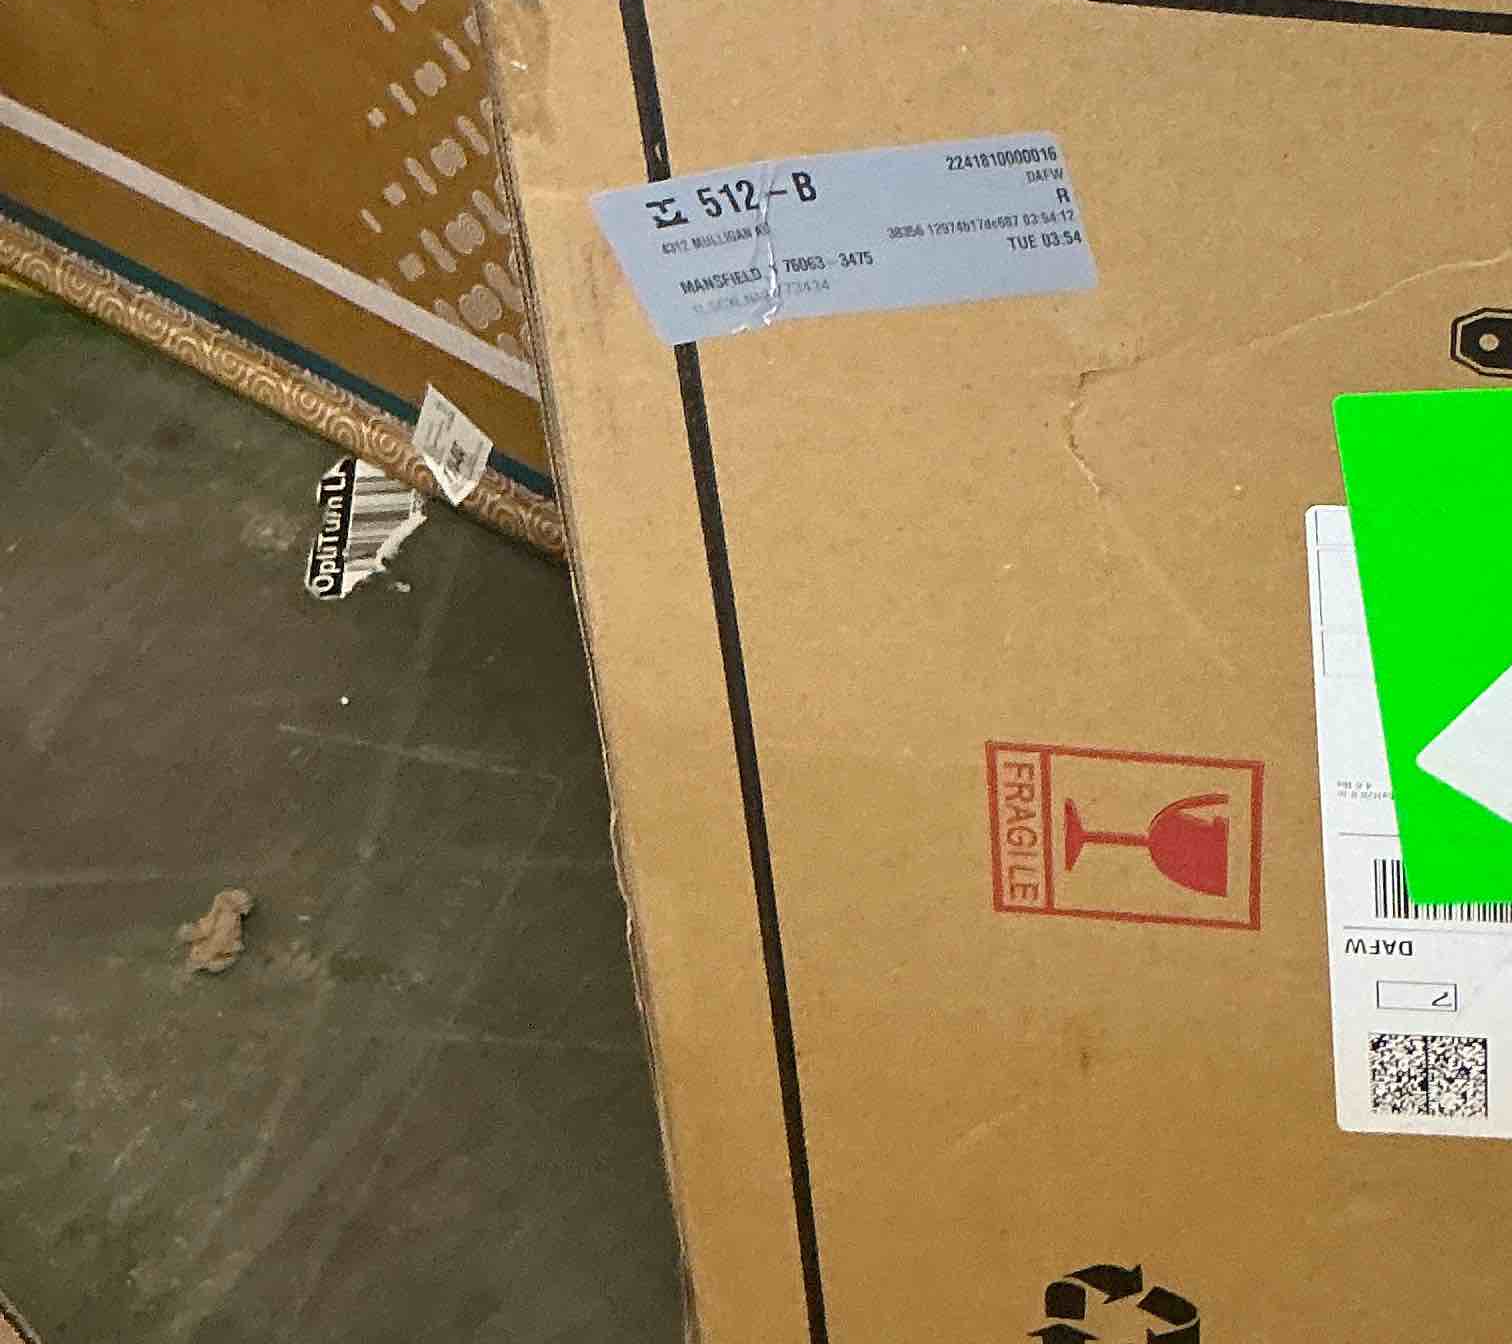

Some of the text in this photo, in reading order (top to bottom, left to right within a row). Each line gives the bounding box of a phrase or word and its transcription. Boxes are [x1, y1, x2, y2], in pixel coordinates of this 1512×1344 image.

[696, 178, 760, 219] 512
[791, 168, 816, 202] B
[1055, 186, 1070, 204] R
[1006, 233, 1038, 252] TUE
[678, 264, 763, 295] MANSFIELD
[1004, 761, 1039, 902] FRAGILE
[1344, 935, 1413, 958] DAFW
